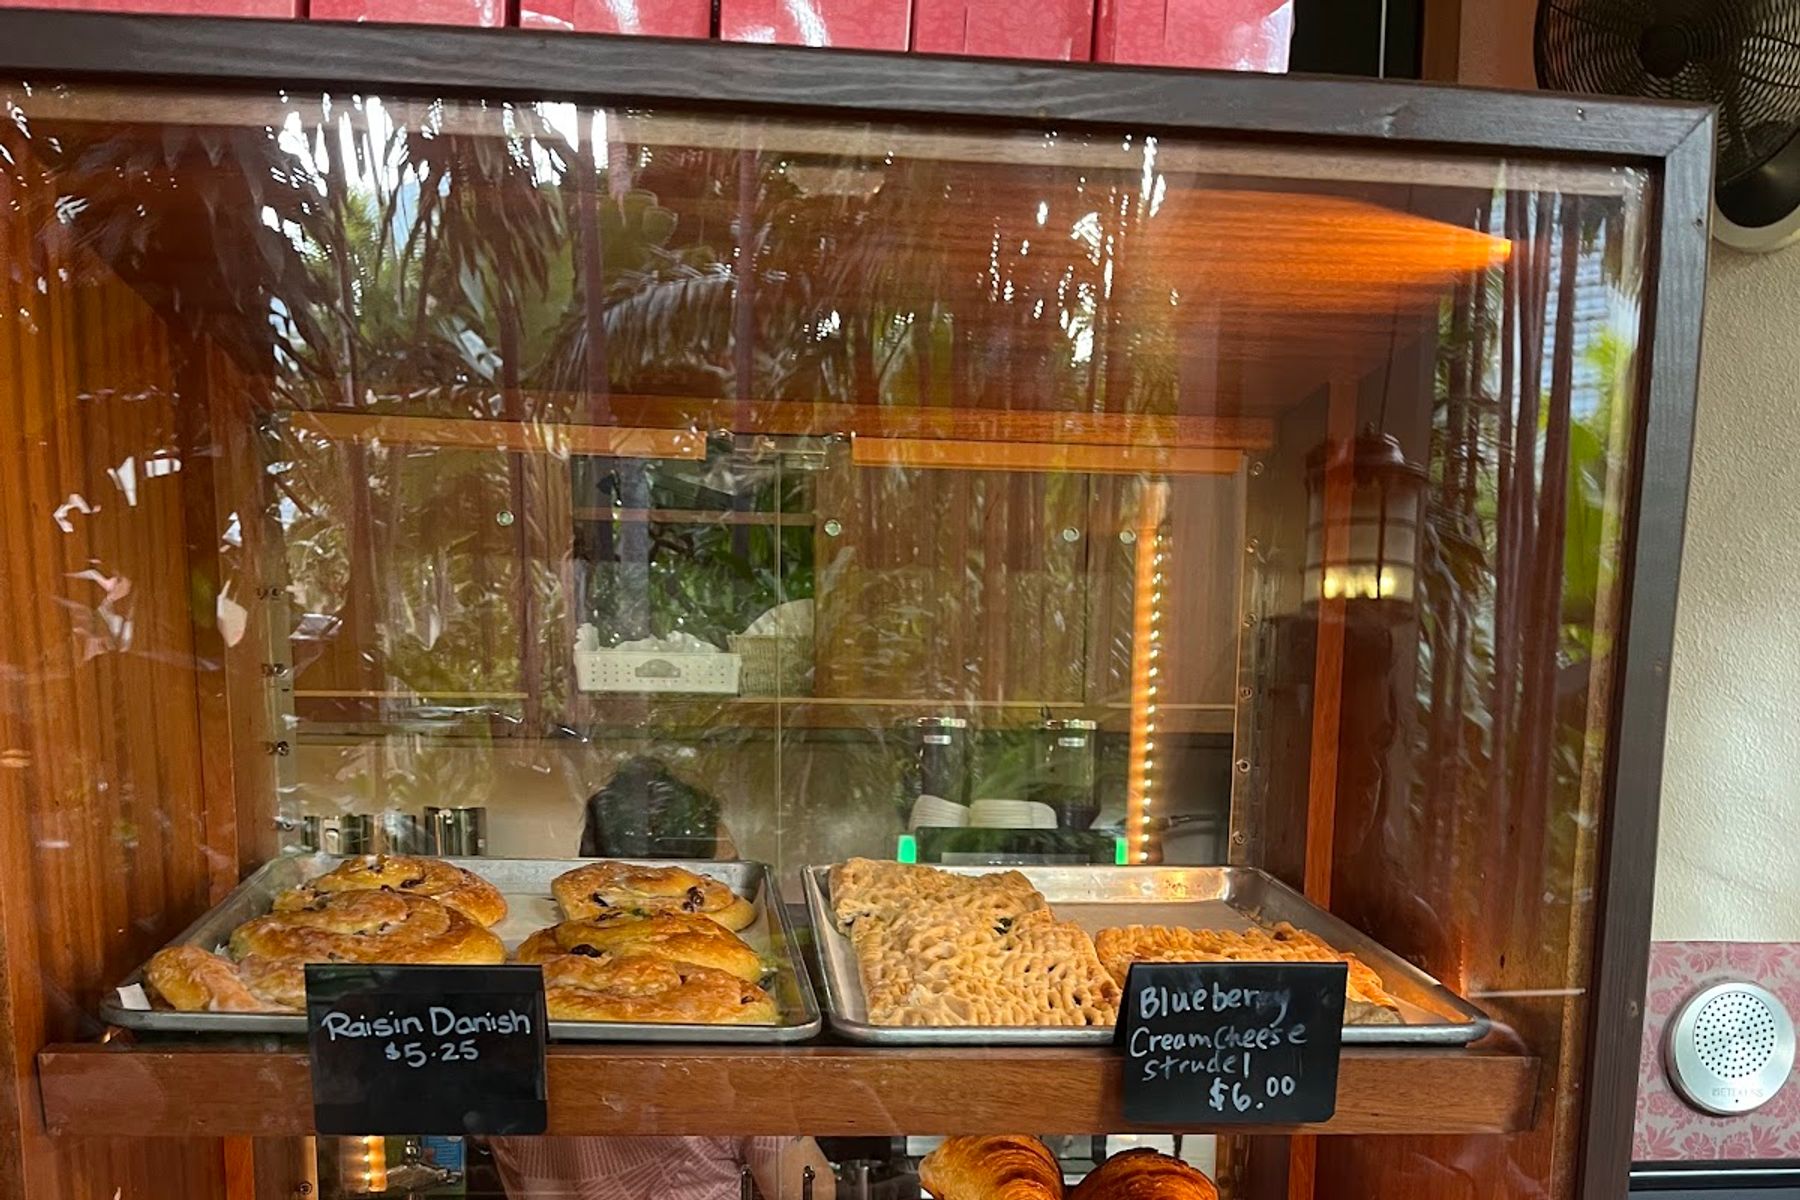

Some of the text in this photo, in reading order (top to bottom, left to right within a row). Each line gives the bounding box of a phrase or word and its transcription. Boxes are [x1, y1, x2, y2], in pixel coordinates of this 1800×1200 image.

[1139, 981, 1291, 1028] Blueberry
[320, 1006, 531, 1041] Raisin Danish
[384, 1038, 479, 1068] $5.25
[1208, 1076, 1296, 1112] $6.00
